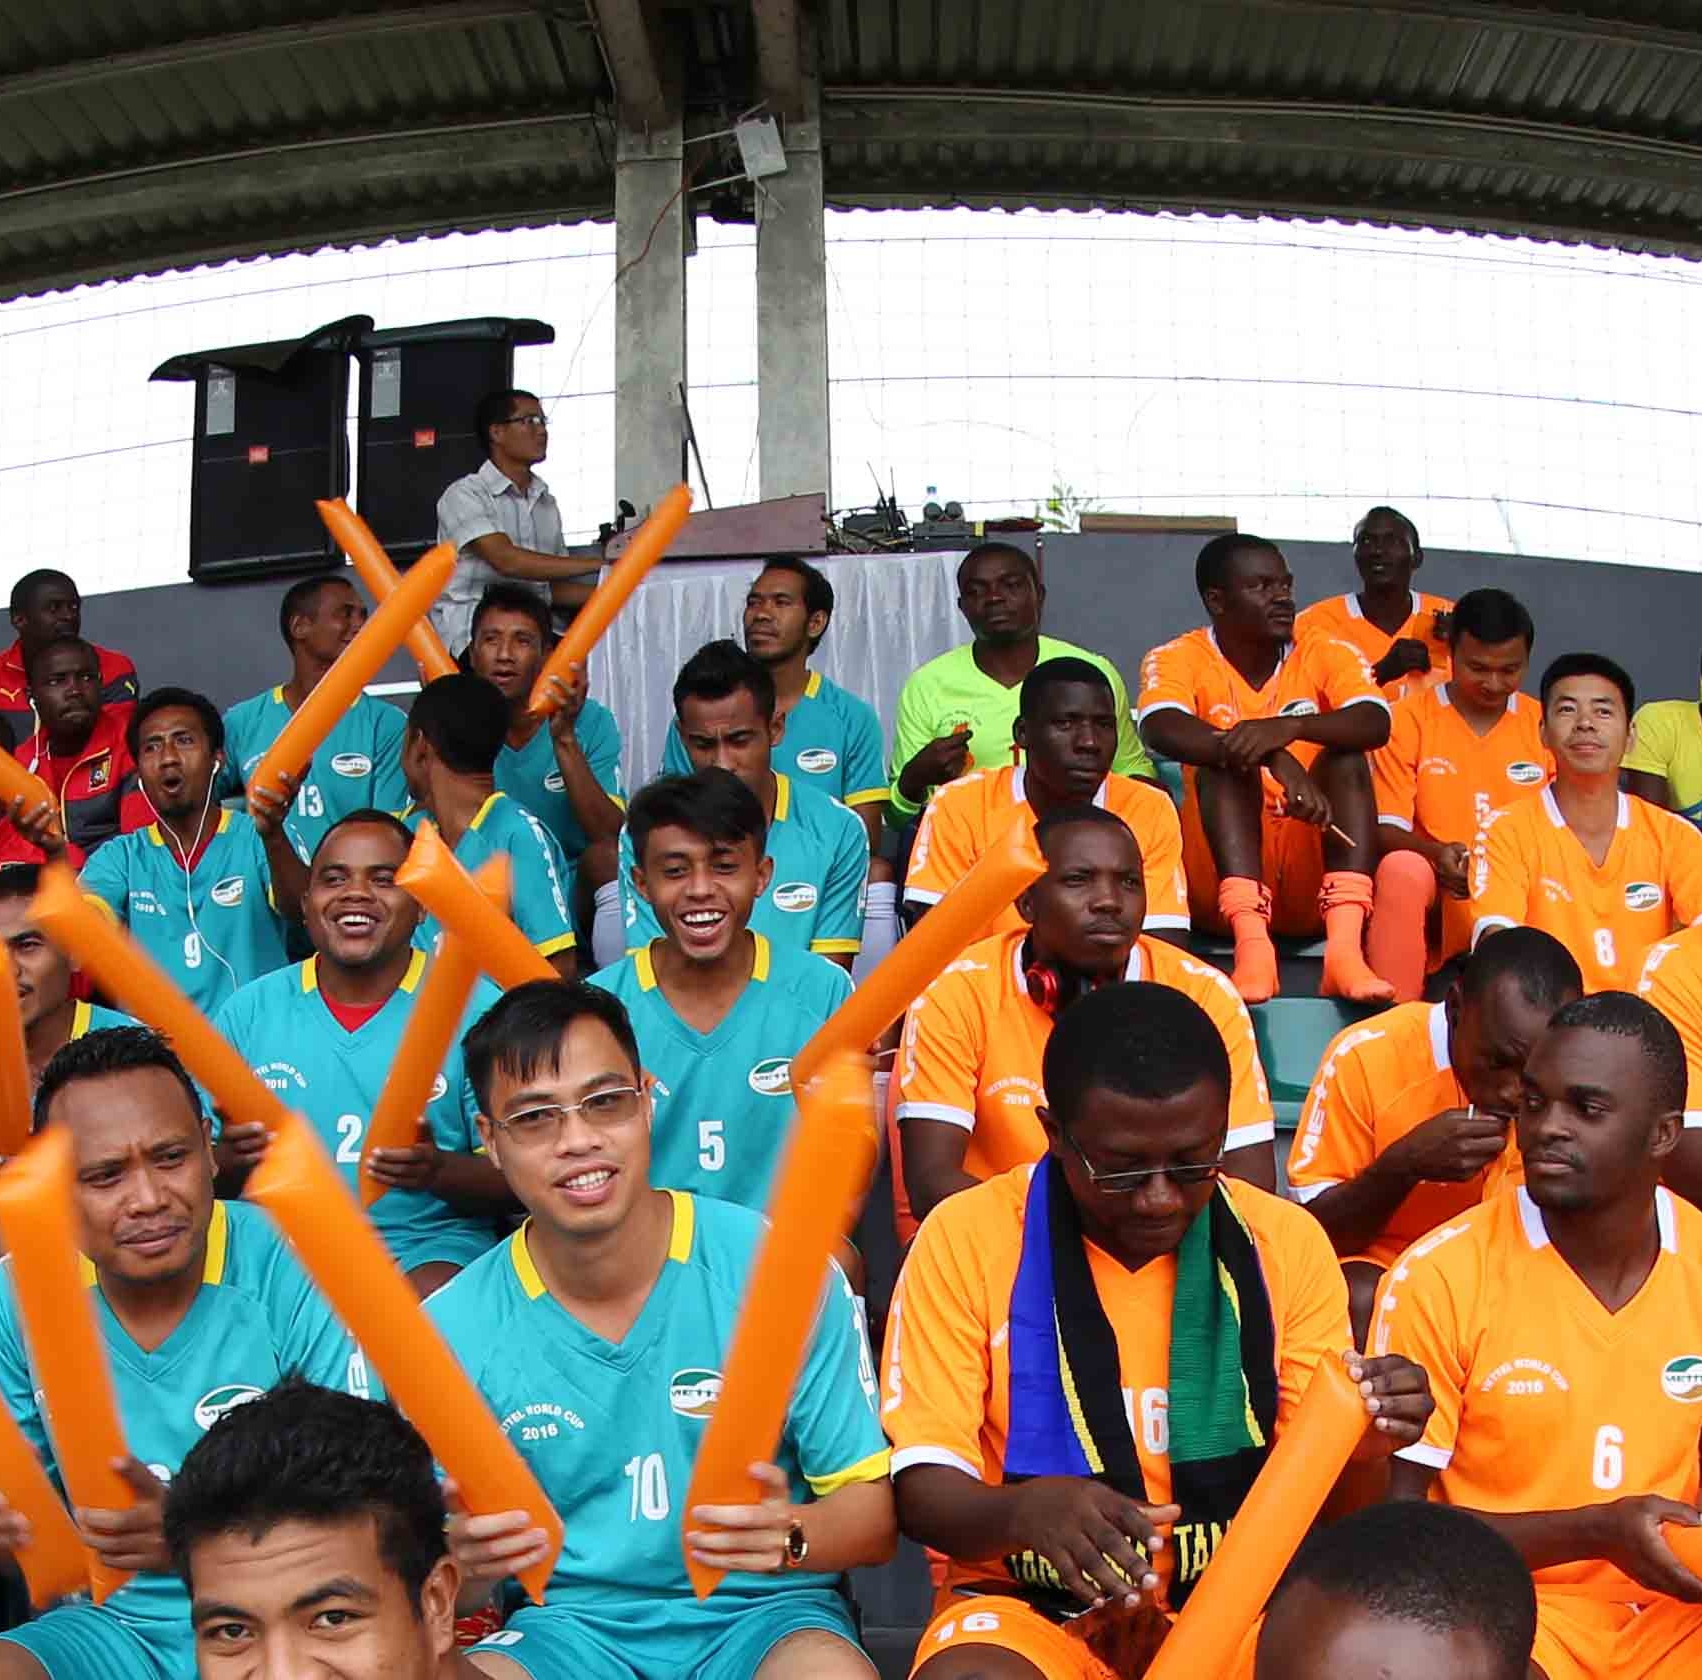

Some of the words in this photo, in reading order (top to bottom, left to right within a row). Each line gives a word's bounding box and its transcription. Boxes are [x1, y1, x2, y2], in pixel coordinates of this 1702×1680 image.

[297, 783, 325, 818] 13
[184, 929, 202, 969] 9
[1594, 929, 1616, 966] 8
[335, 1114, 362, 1162] 2
[698, 1120, 725, 1170] 5
[1506, 1380, 1545, 1395] 2016
[521, 1423, 560, 1441] 2016
[525, 1403, 564, 1419] WORLD
[563, 1409, 586, 1431] CUP
[1120, 1386, 1169, 1456] 16
[1592, 1425, 1625, 1491] 6
[624, 1451, 670, 1523] 10
[933, 1611, 1001, 1643] 16
